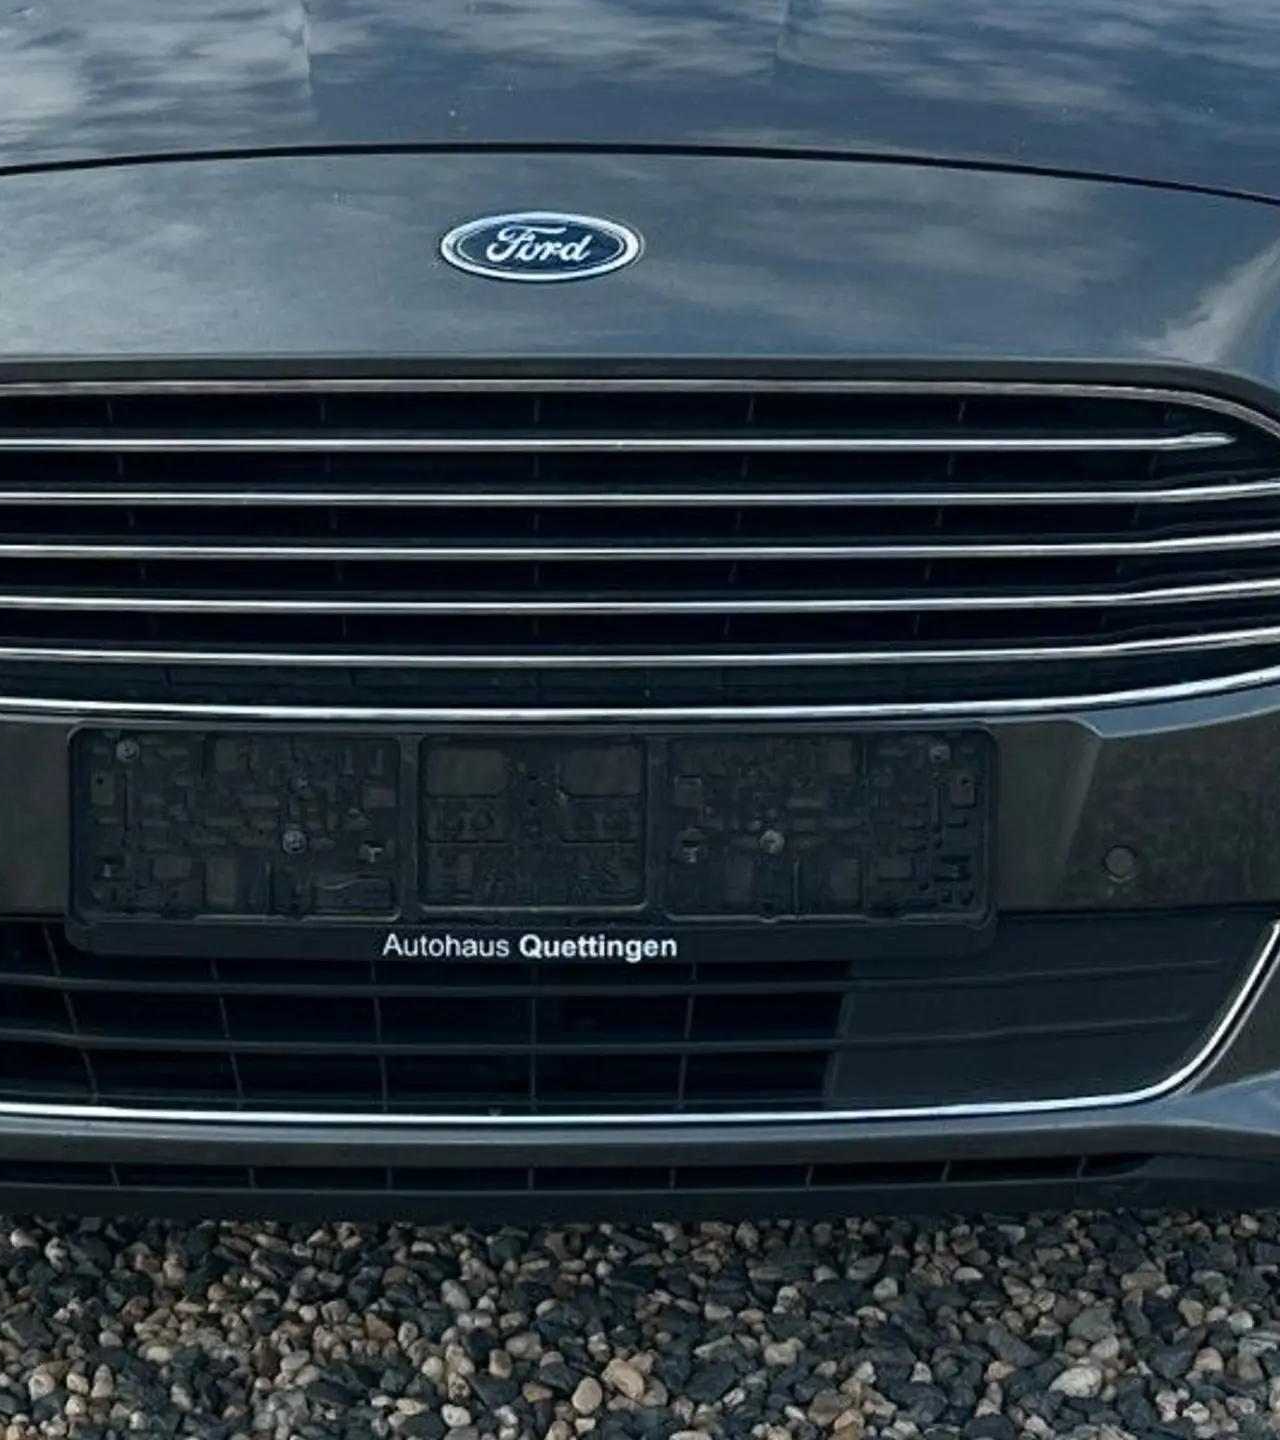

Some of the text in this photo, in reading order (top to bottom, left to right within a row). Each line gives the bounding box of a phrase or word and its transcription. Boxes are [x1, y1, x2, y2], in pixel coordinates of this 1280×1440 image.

[486, 225, 593, 262] Ford
[382, 933, 678, 963] Autohaus Quettingen
